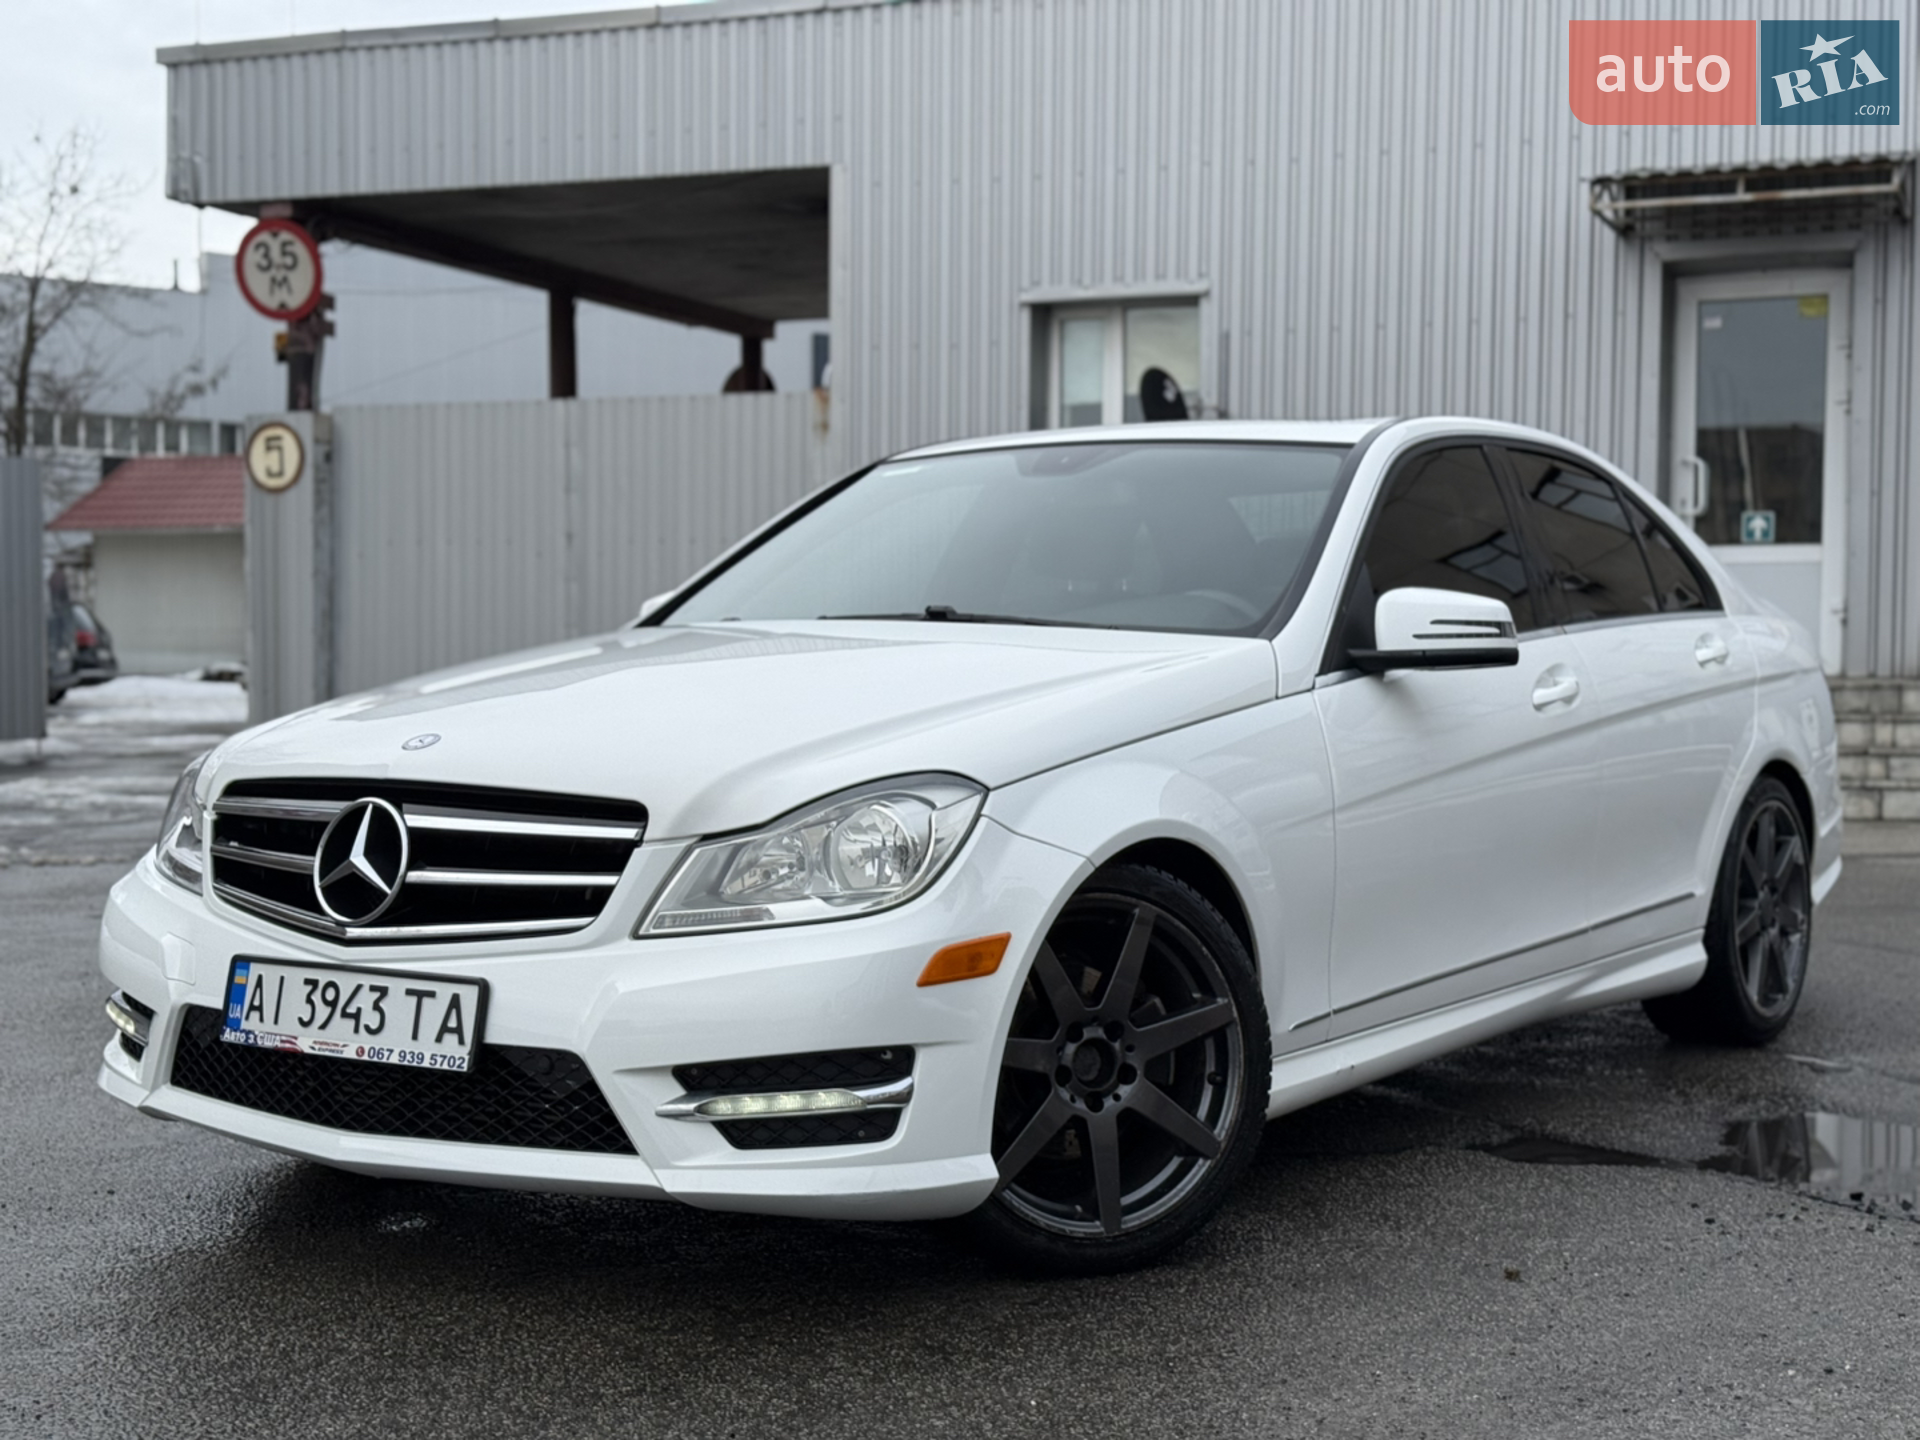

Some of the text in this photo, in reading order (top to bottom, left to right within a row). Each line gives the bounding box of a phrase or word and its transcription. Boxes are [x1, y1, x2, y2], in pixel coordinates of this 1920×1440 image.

[264, 436, 284, 478] 5
[228, 1002, 242, 1019] UA
[244, 973, 466, 1046] AI 3943 TA
[367, 1046, 466, 1070] 067 939 5702
